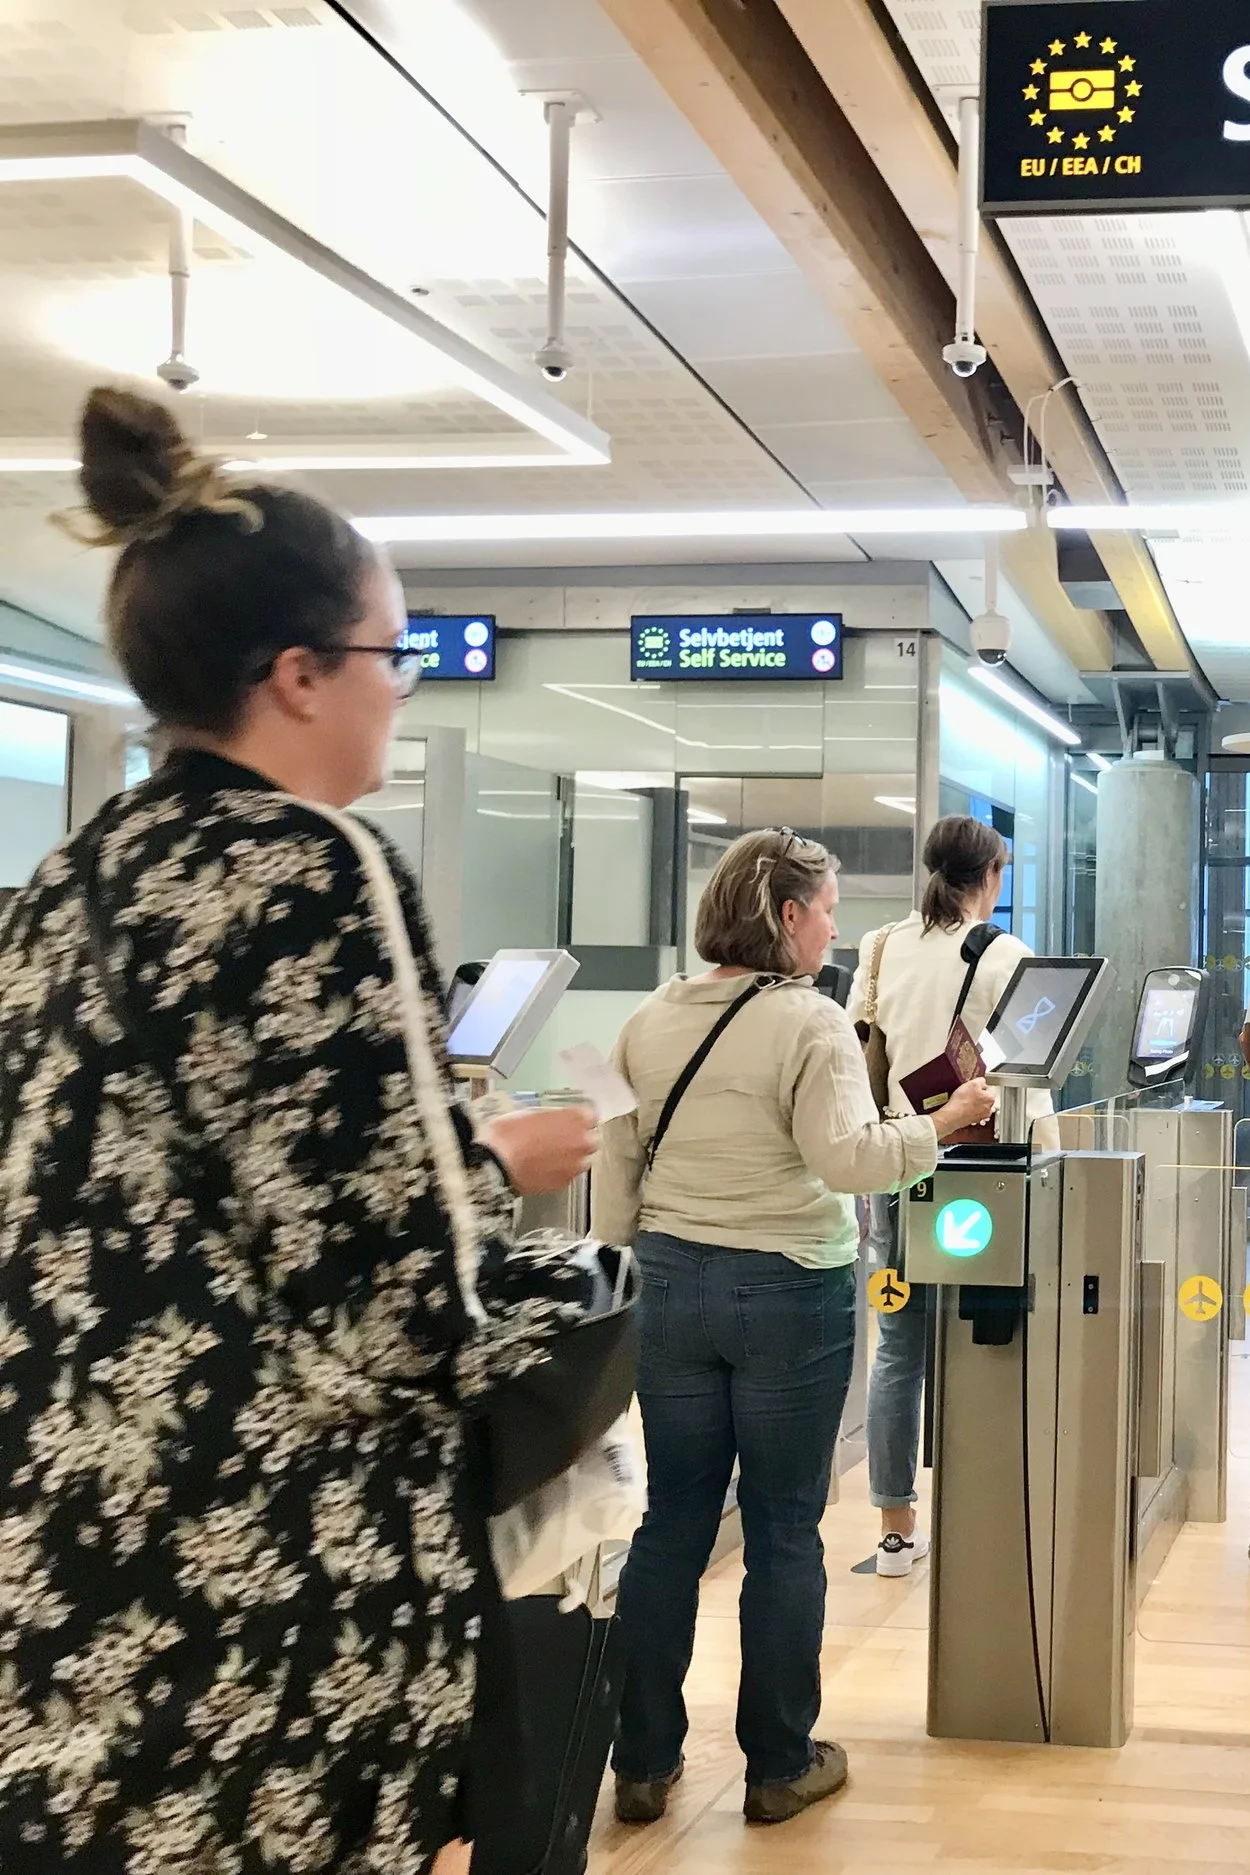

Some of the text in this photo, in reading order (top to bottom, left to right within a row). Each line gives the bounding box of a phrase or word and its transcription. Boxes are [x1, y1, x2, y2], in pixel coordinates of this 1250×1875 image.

[1020, 155, 1141, 176] EU / EEA / CH
[679, 627, 784, 652] Selvbetjent
[897, 642, 916, 657] 14
[679, 648, 715, 668] Self
[719, 648, 787, 668] Service
[916, 1181, 927, 1198] 9
